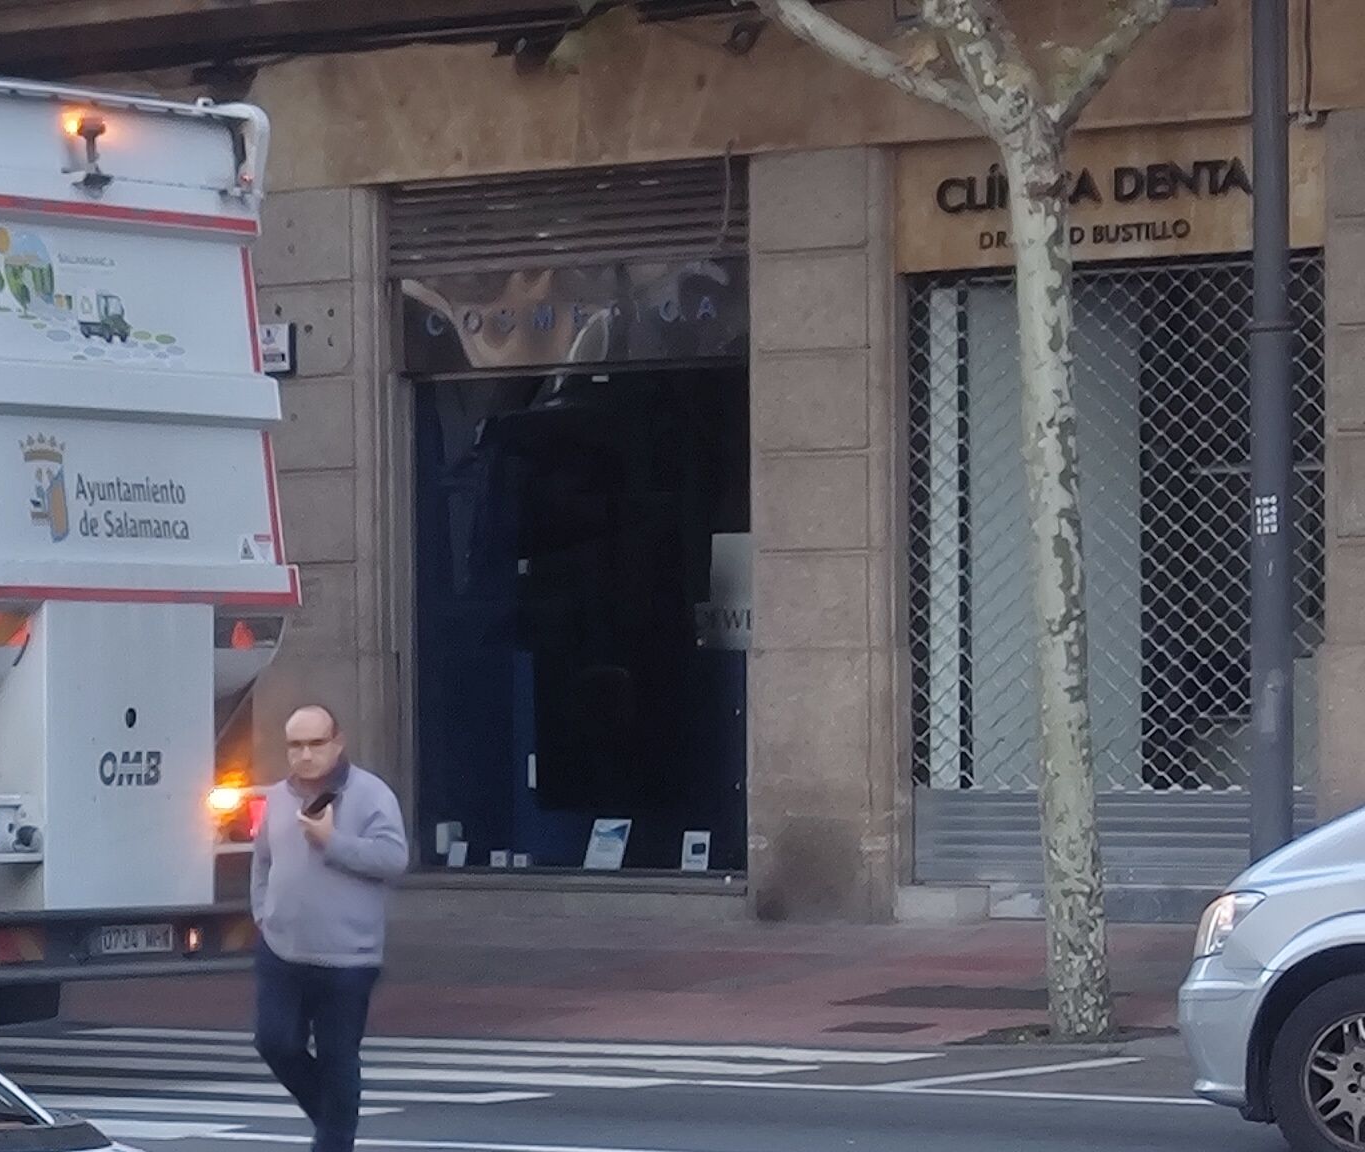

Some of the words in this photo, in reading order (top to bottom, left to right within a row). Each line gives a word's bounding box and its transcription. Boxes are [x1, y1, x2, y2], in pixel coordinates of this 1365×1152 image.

[1114, 157, 1254, 201] DENTA
[1092, 218, 1191, 244] BUSTILLO
[75, 472, 187, 507] Ayuntamiento
[79, 509, 99, 538] de
[104, 510, 190, 540] Salamanca
[99, 750, 162, 786] OMB
